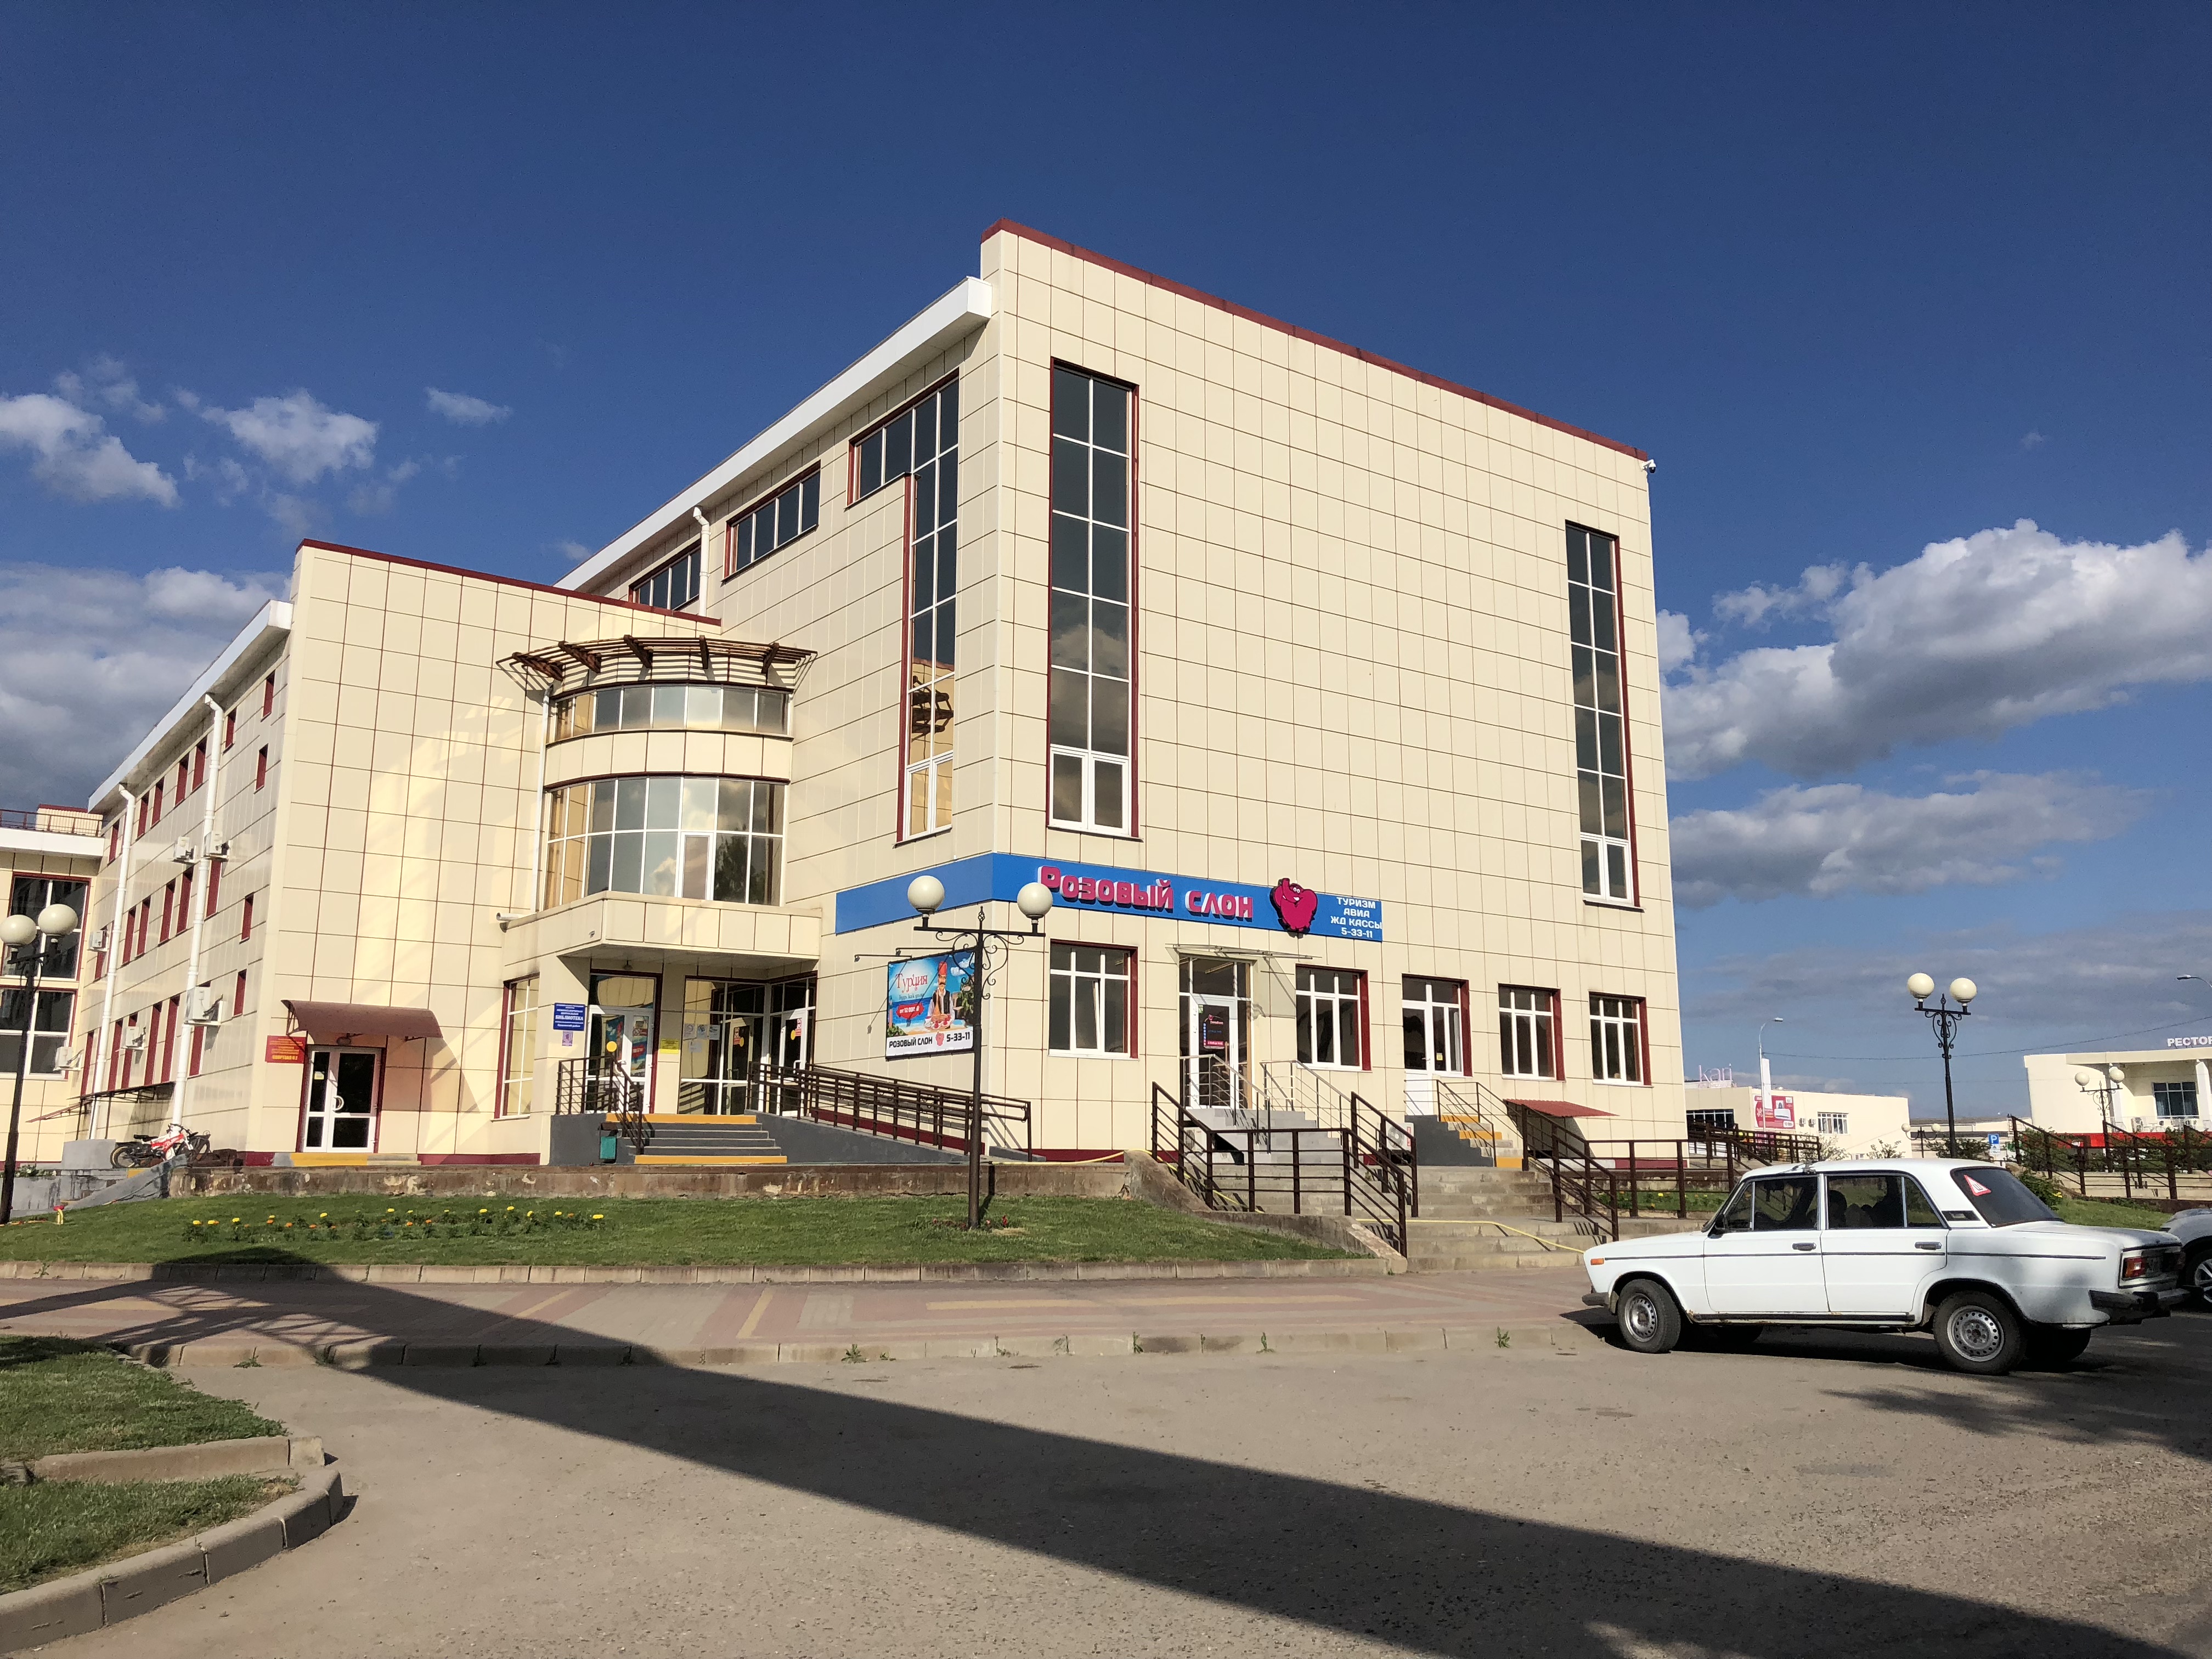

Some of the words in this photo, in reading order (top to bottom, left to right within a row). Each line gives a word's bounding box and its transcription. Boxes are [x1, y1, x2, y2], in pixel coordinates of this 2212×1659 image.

[1038, 866, 1173, 910] РОЗОВЫЙ
[1186, 890, 1253, 918] СЛОН
[1336, 897, 1375, 909] ТУРИЗМ
[1344, 908, 1370, 918] АВИА
[1330, 916, 1346, 925] ЖД
[1348, 918, 1382, 929] КАССЫ
[1341, 927, 1373, 938] 5-33-11
[895, 973, 928, 993] Турция
[889, 1037, 917, 1048] РОЗОВЫЙ
[918, 1036, 933, 1046] СЛОН
[946, 1032, 970, 1042] 5-33-11
[1699, 1063, 1732, 1083] kari
